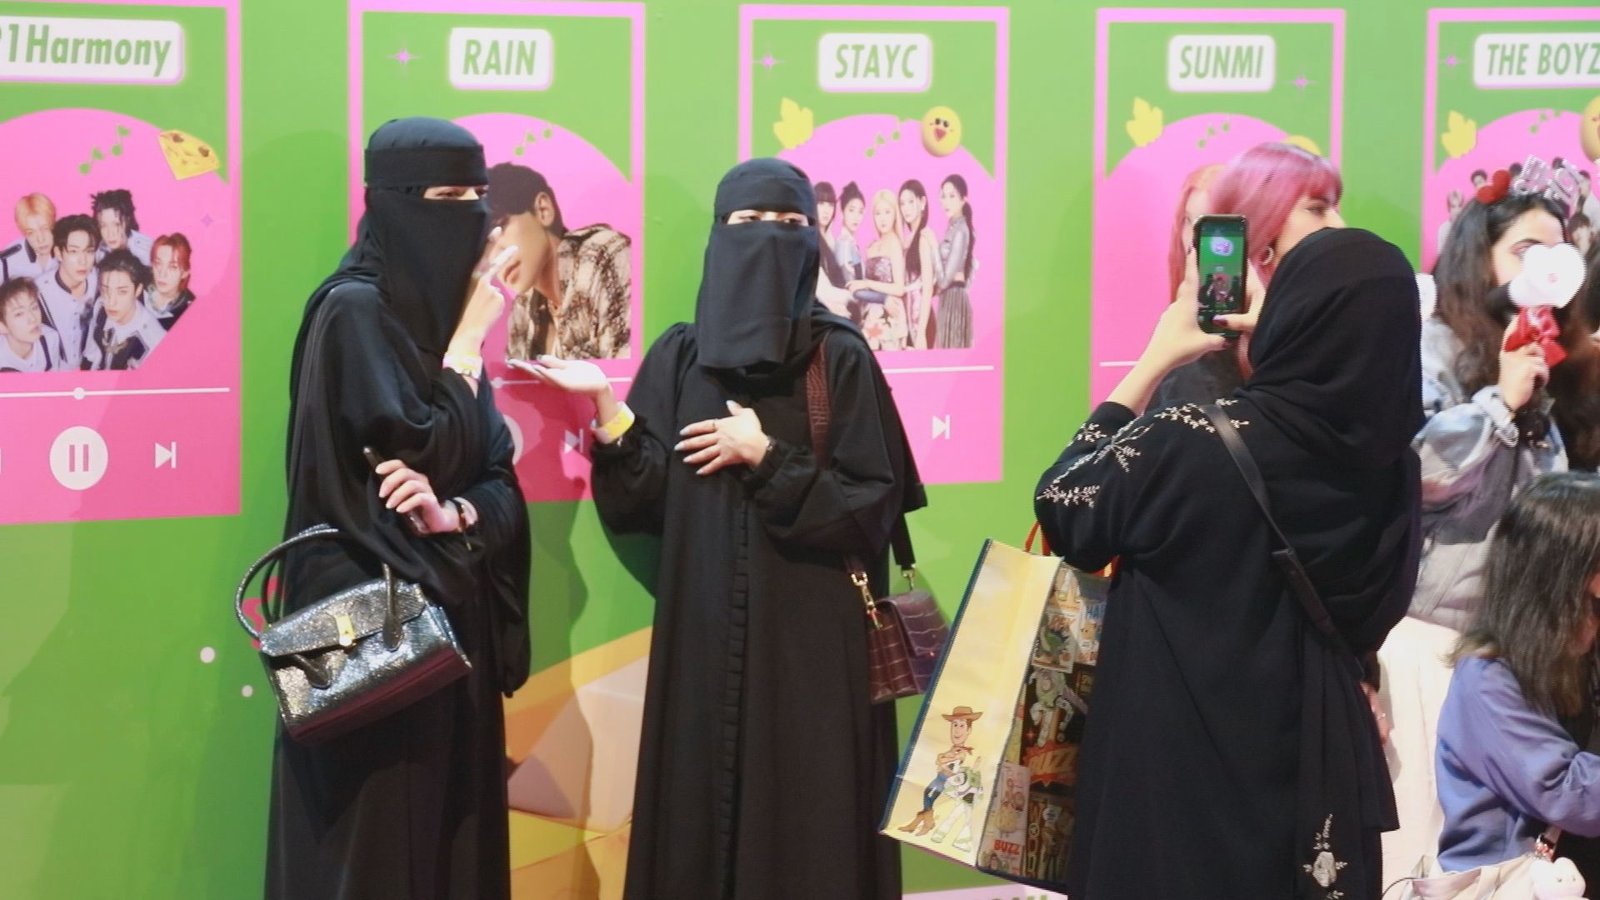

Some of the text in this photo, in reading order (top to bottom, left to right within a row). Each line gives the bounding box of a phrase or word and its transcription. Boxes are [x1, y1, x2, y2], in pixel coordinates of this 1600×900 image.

[0, 23, 172, 77] 1Harmony
[463, 39, 537, 76] RAIN
[834, 43, 918, 79] STAYC
[1179, 45, 1264, 79] SUNMI
[1487, 42, 1600, 76] THE BOYZ
[993, 839, 1020, 856] BUZZ
